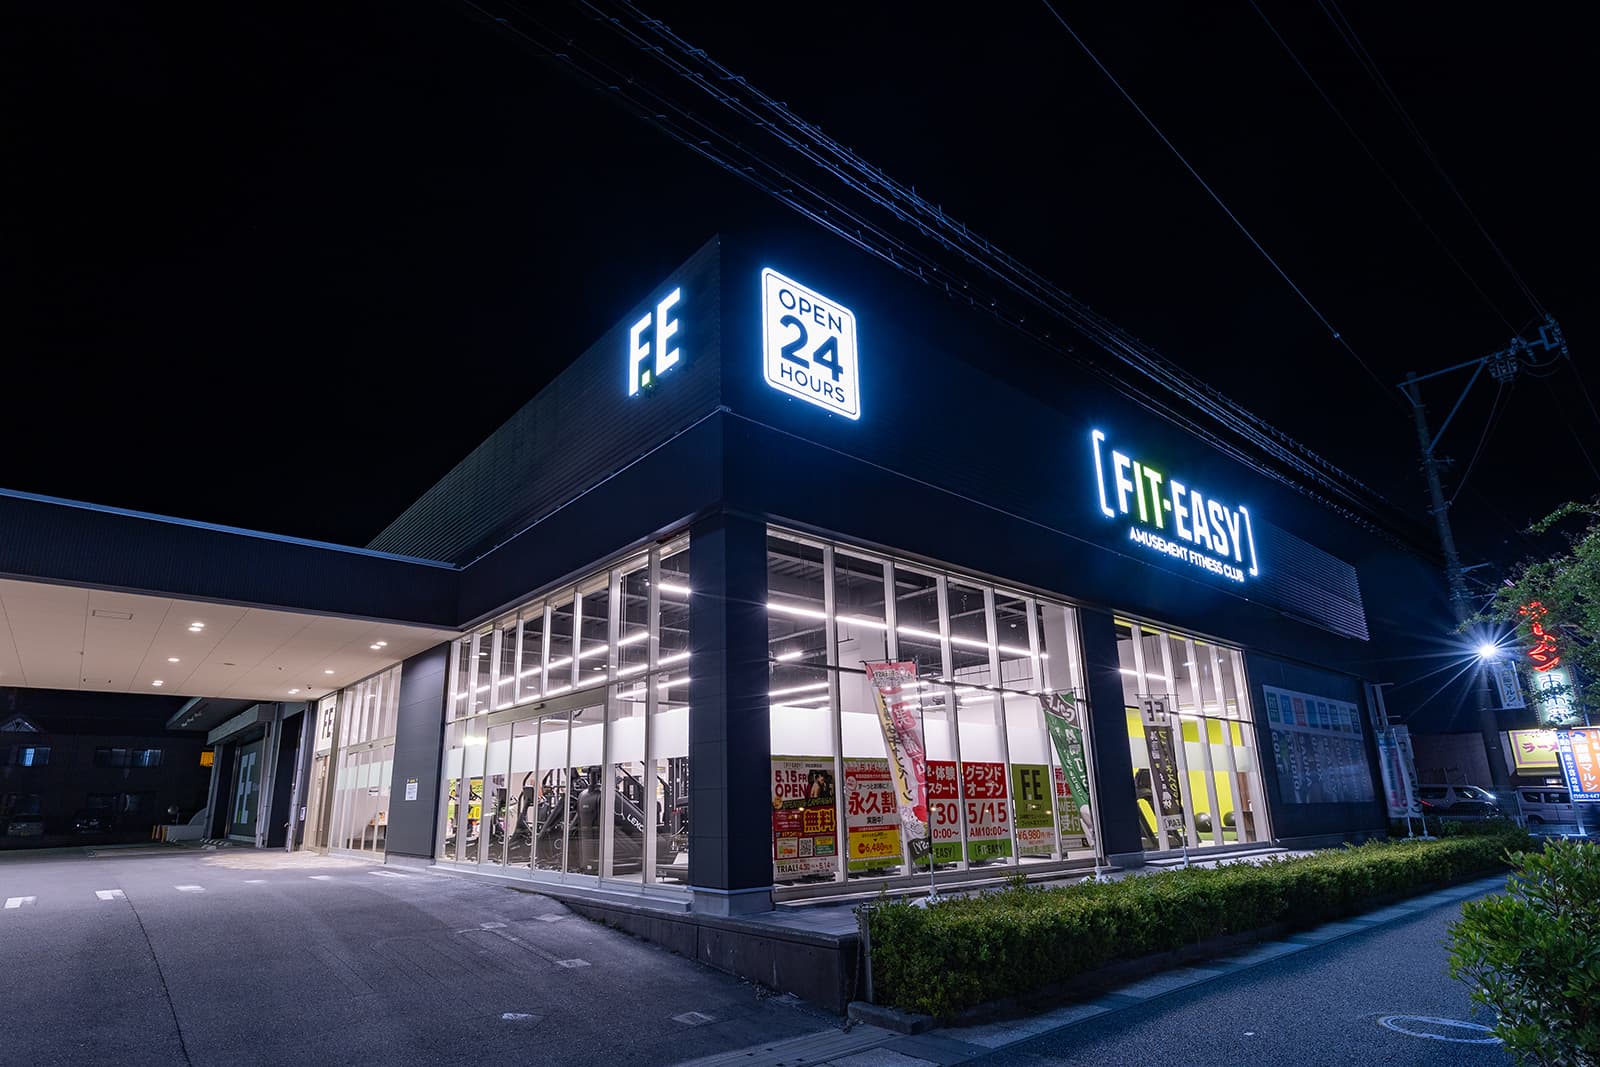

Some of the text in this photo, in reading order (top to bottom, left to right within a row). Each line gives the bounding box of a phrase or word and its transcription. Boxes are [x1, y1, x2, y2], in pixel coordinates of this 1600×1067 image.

[779, 289, 842, 334] OPEN
[780, 315, 843, 383] 24
[781, 363, 846, 403] HOURS
[1130, 527, 1245, 582] AMUSEMENT FITNESS CLUB
[775, 770, 797, 783] 5.15
[966, 766, 1002, 781] グランド
[928, 782, 956, 795] スタート
[966, 781, 1004, 797] オープン
[848, 791, 897, 816] 永久割
[967, 801, 1008, 824] 5/15
[804, 809, 836, 832] 無料
